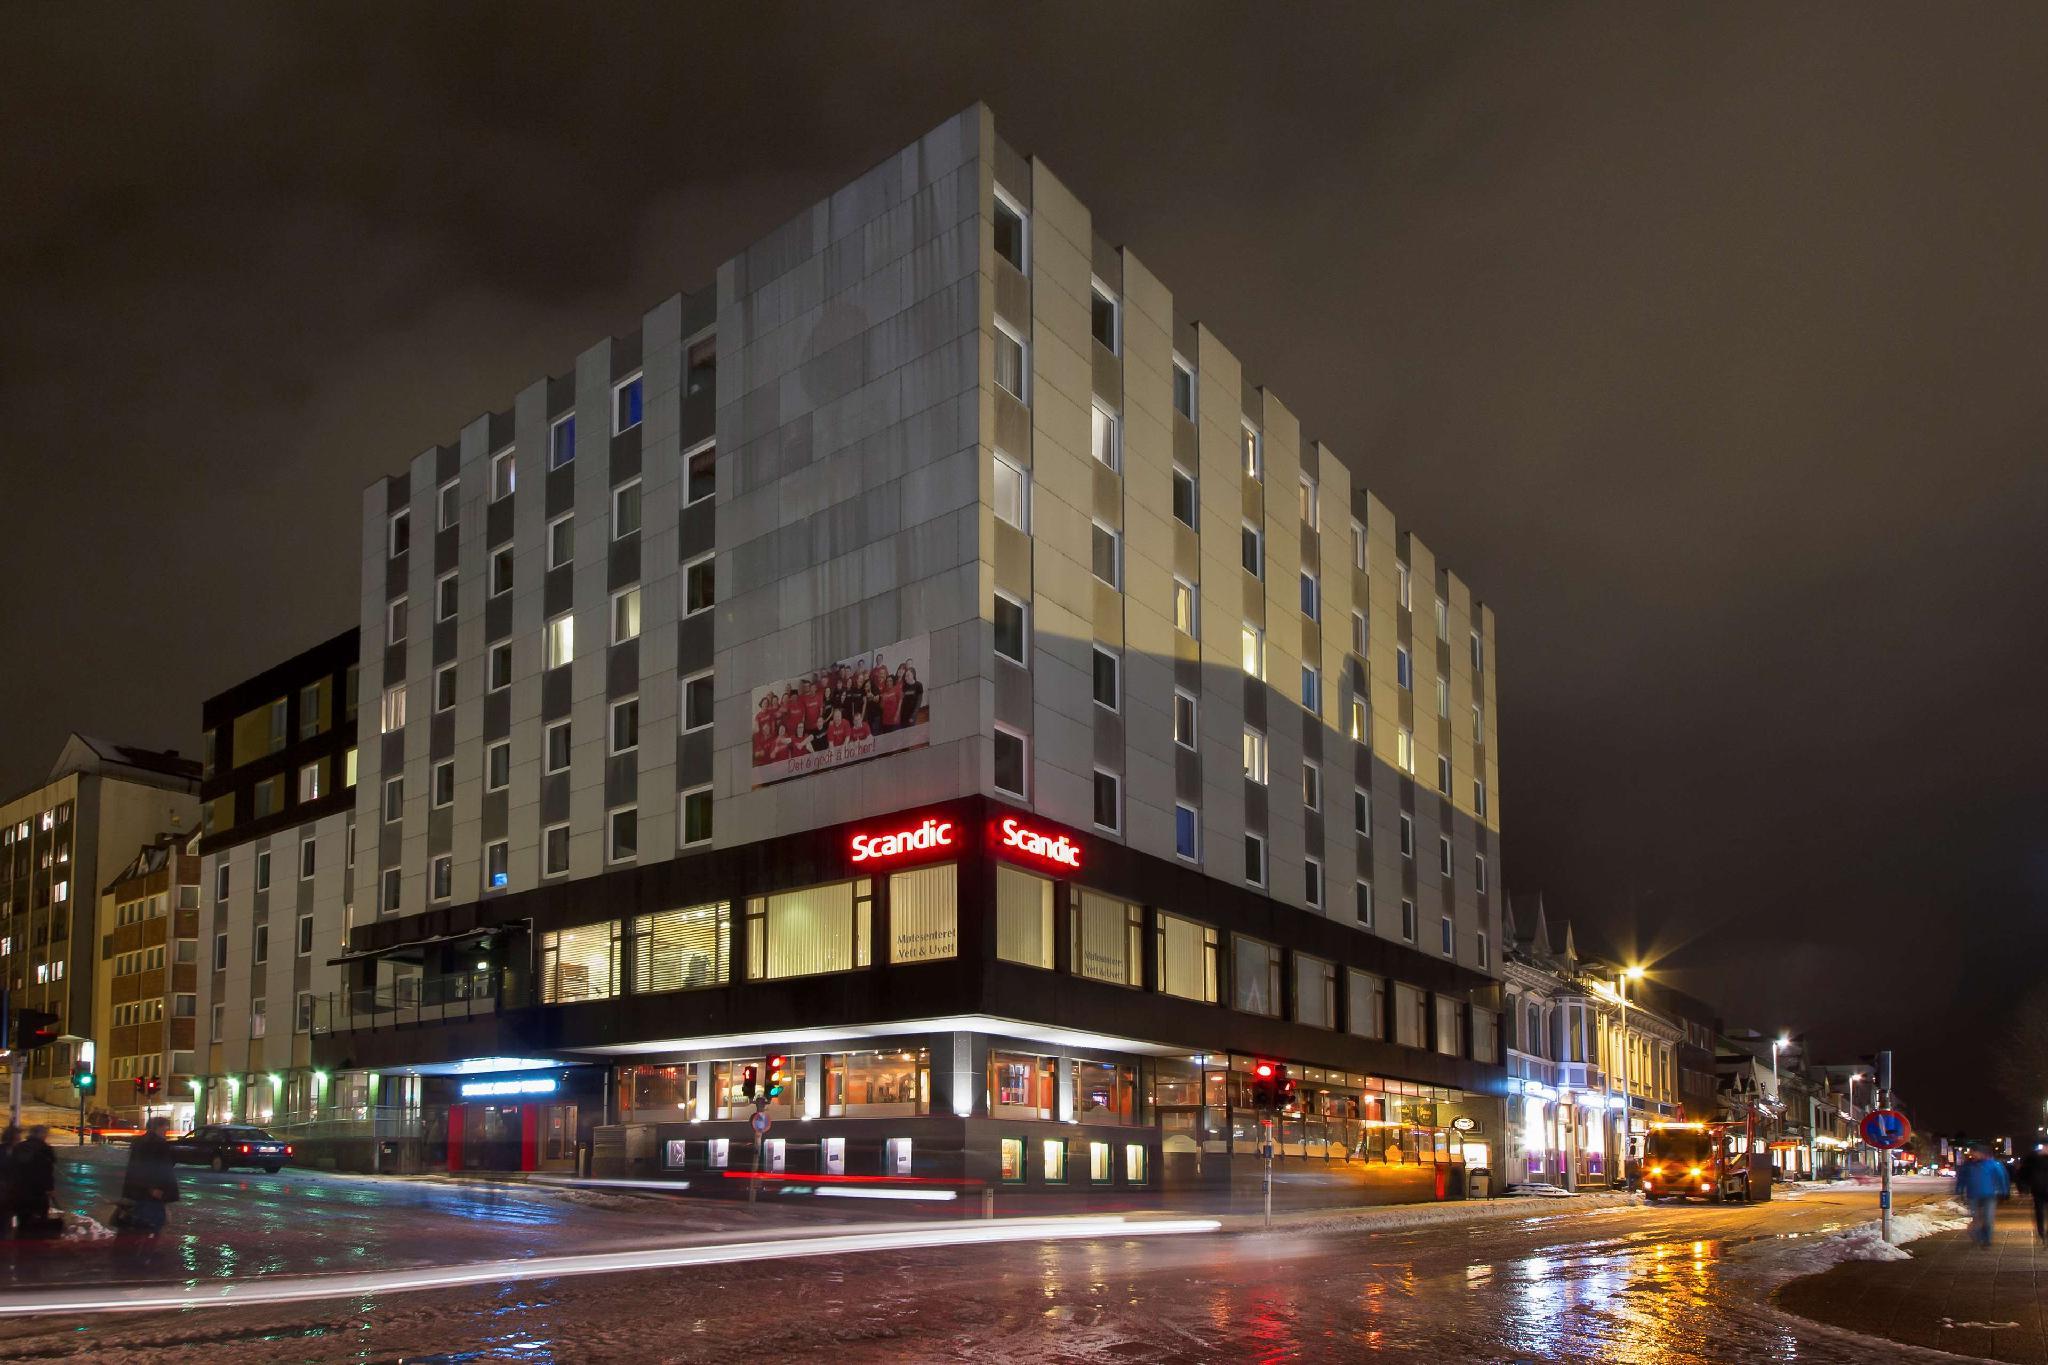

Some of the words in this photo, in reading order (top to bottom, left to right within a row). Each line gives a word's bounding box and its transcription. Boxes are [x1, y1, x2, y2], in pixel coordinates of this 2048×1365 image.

[852, 820, 951, 861] Scandic
[1003, 819, 1079, 867] Scandic
[918, 946, 926, 956] &
